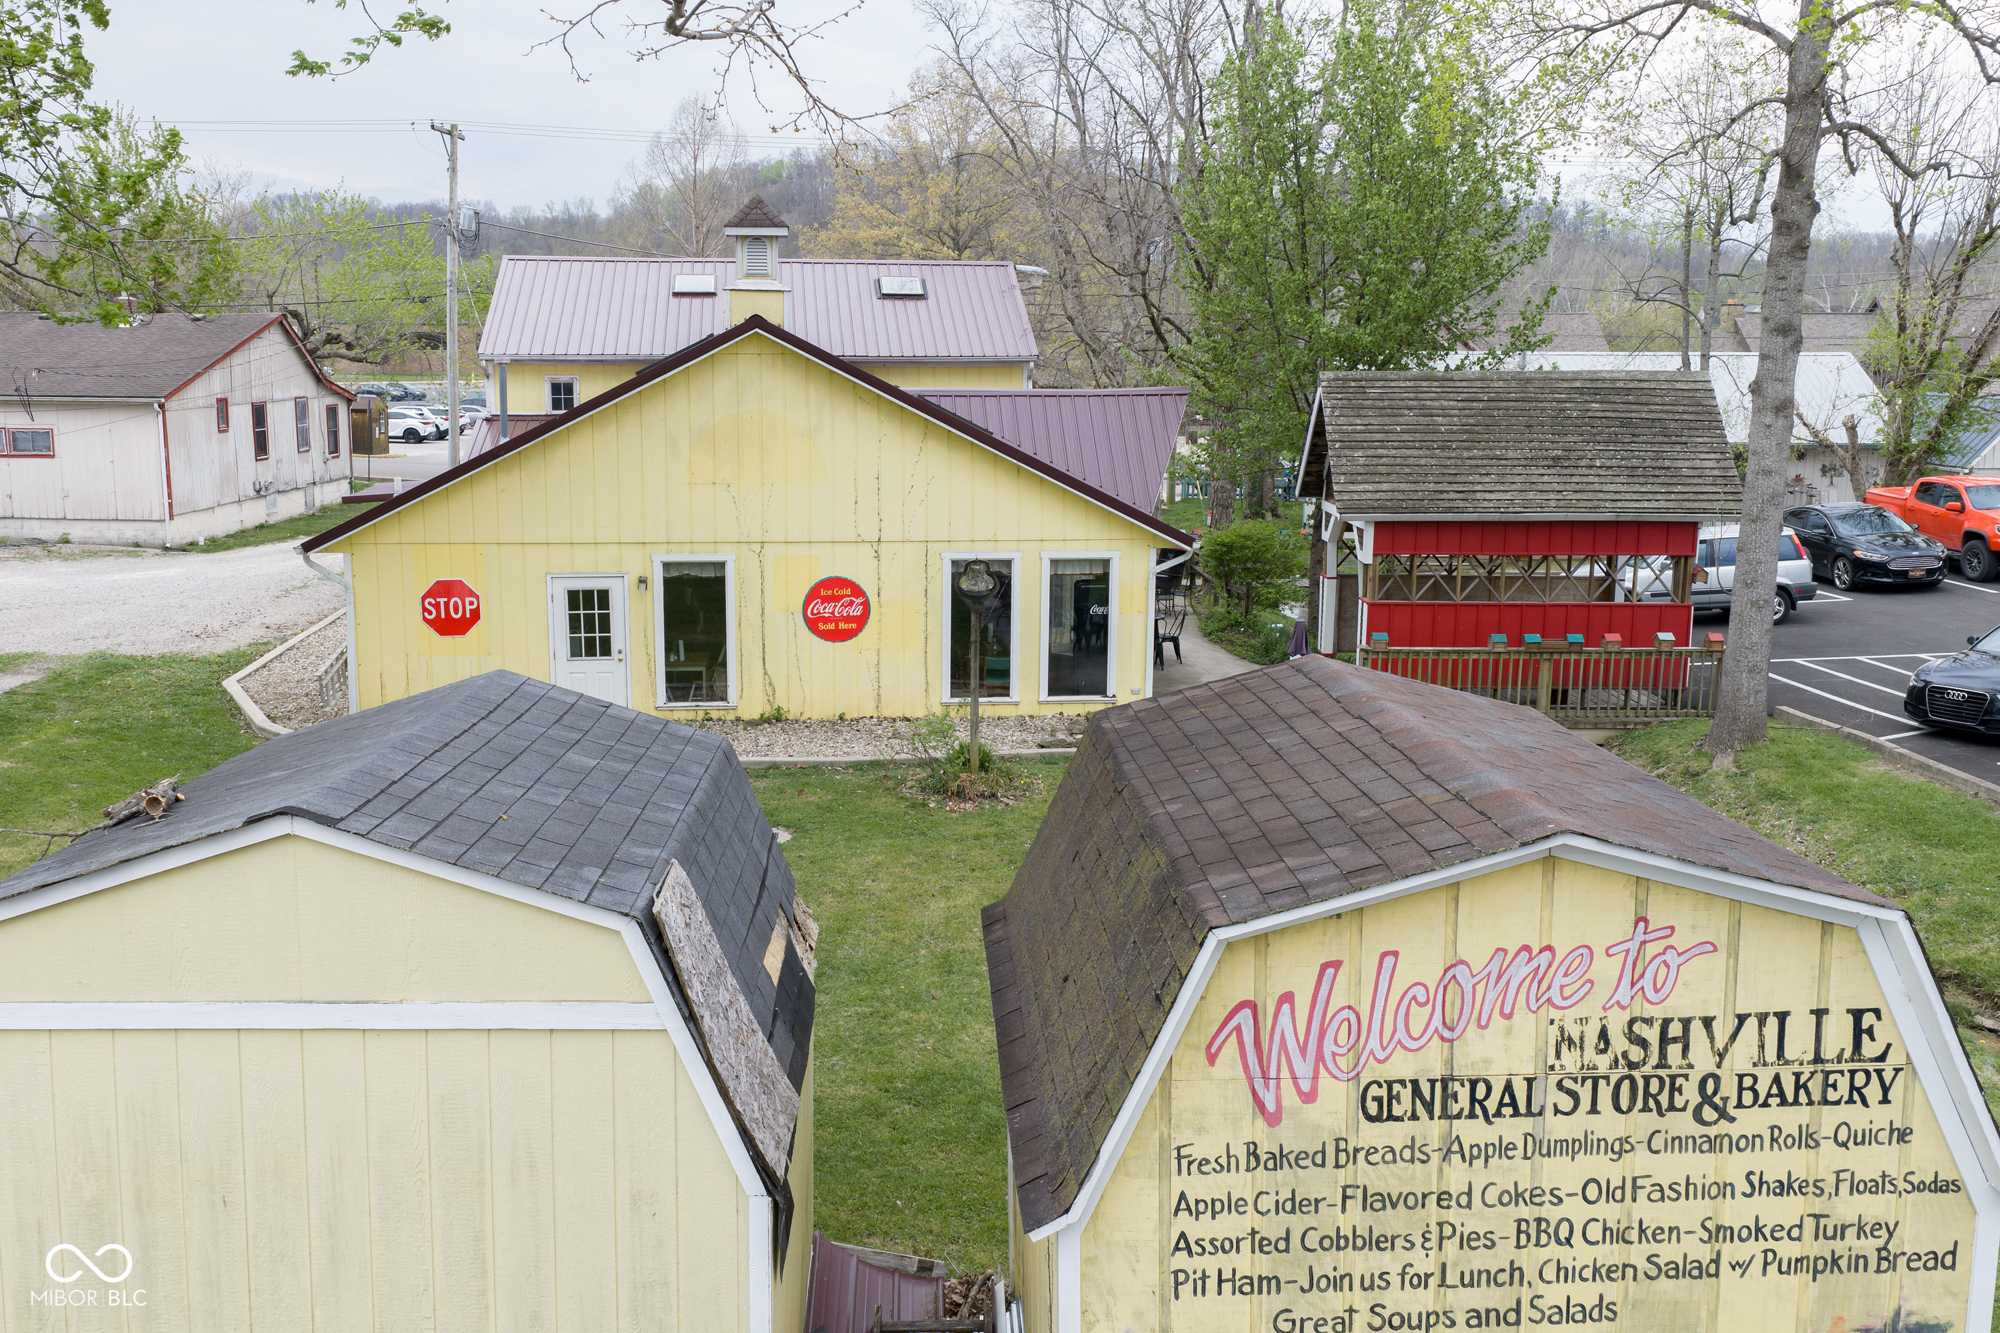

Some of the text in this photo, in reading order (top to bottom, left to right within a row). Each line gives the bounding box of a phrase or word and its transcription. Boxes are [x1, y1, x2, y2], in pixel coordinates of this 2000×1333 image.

[424, 597, 478, 619] STOP
[807, 597, 866, 618] Coca-Cola
[821, 588, 833, 596] Ice
[818, 622, 835, 630] Sold
[1206, 916, 1718, 1128] Welcome to
[1548, 1008, 1893, 1073] NASHVILLE
[1360, 1075, 1544, 1125] GENERAL
[1173, 1143, 1239, 1176] Fresh
[1244, 1141, 1326, 1172] Baked
[1173, 1190, 1248, 1221] Apple
[1631, 1175, 1735, 1203] Fashion
[1171, 1227, 1290, 1258] Assorted
[1301, 1225, 1415, 1253] Cobblers
[1807, 1213, 1899, 1250] Turkey
[1171, 1268, 1211, 1300] Pit
[1360, 1268, 1391, 1291] us
[1400, 1263, 1435, 1293] for
[1539, 1257, 1637, 1284] Chicken
[1644, 1250, 1721, 1282] Salad
[1761, 1247, 1868, 1282] Pumpkin
[1875, 1240, 1958, 1274] Bread
[1273, 1293, 1618, 1333] Great Soups and Salads
